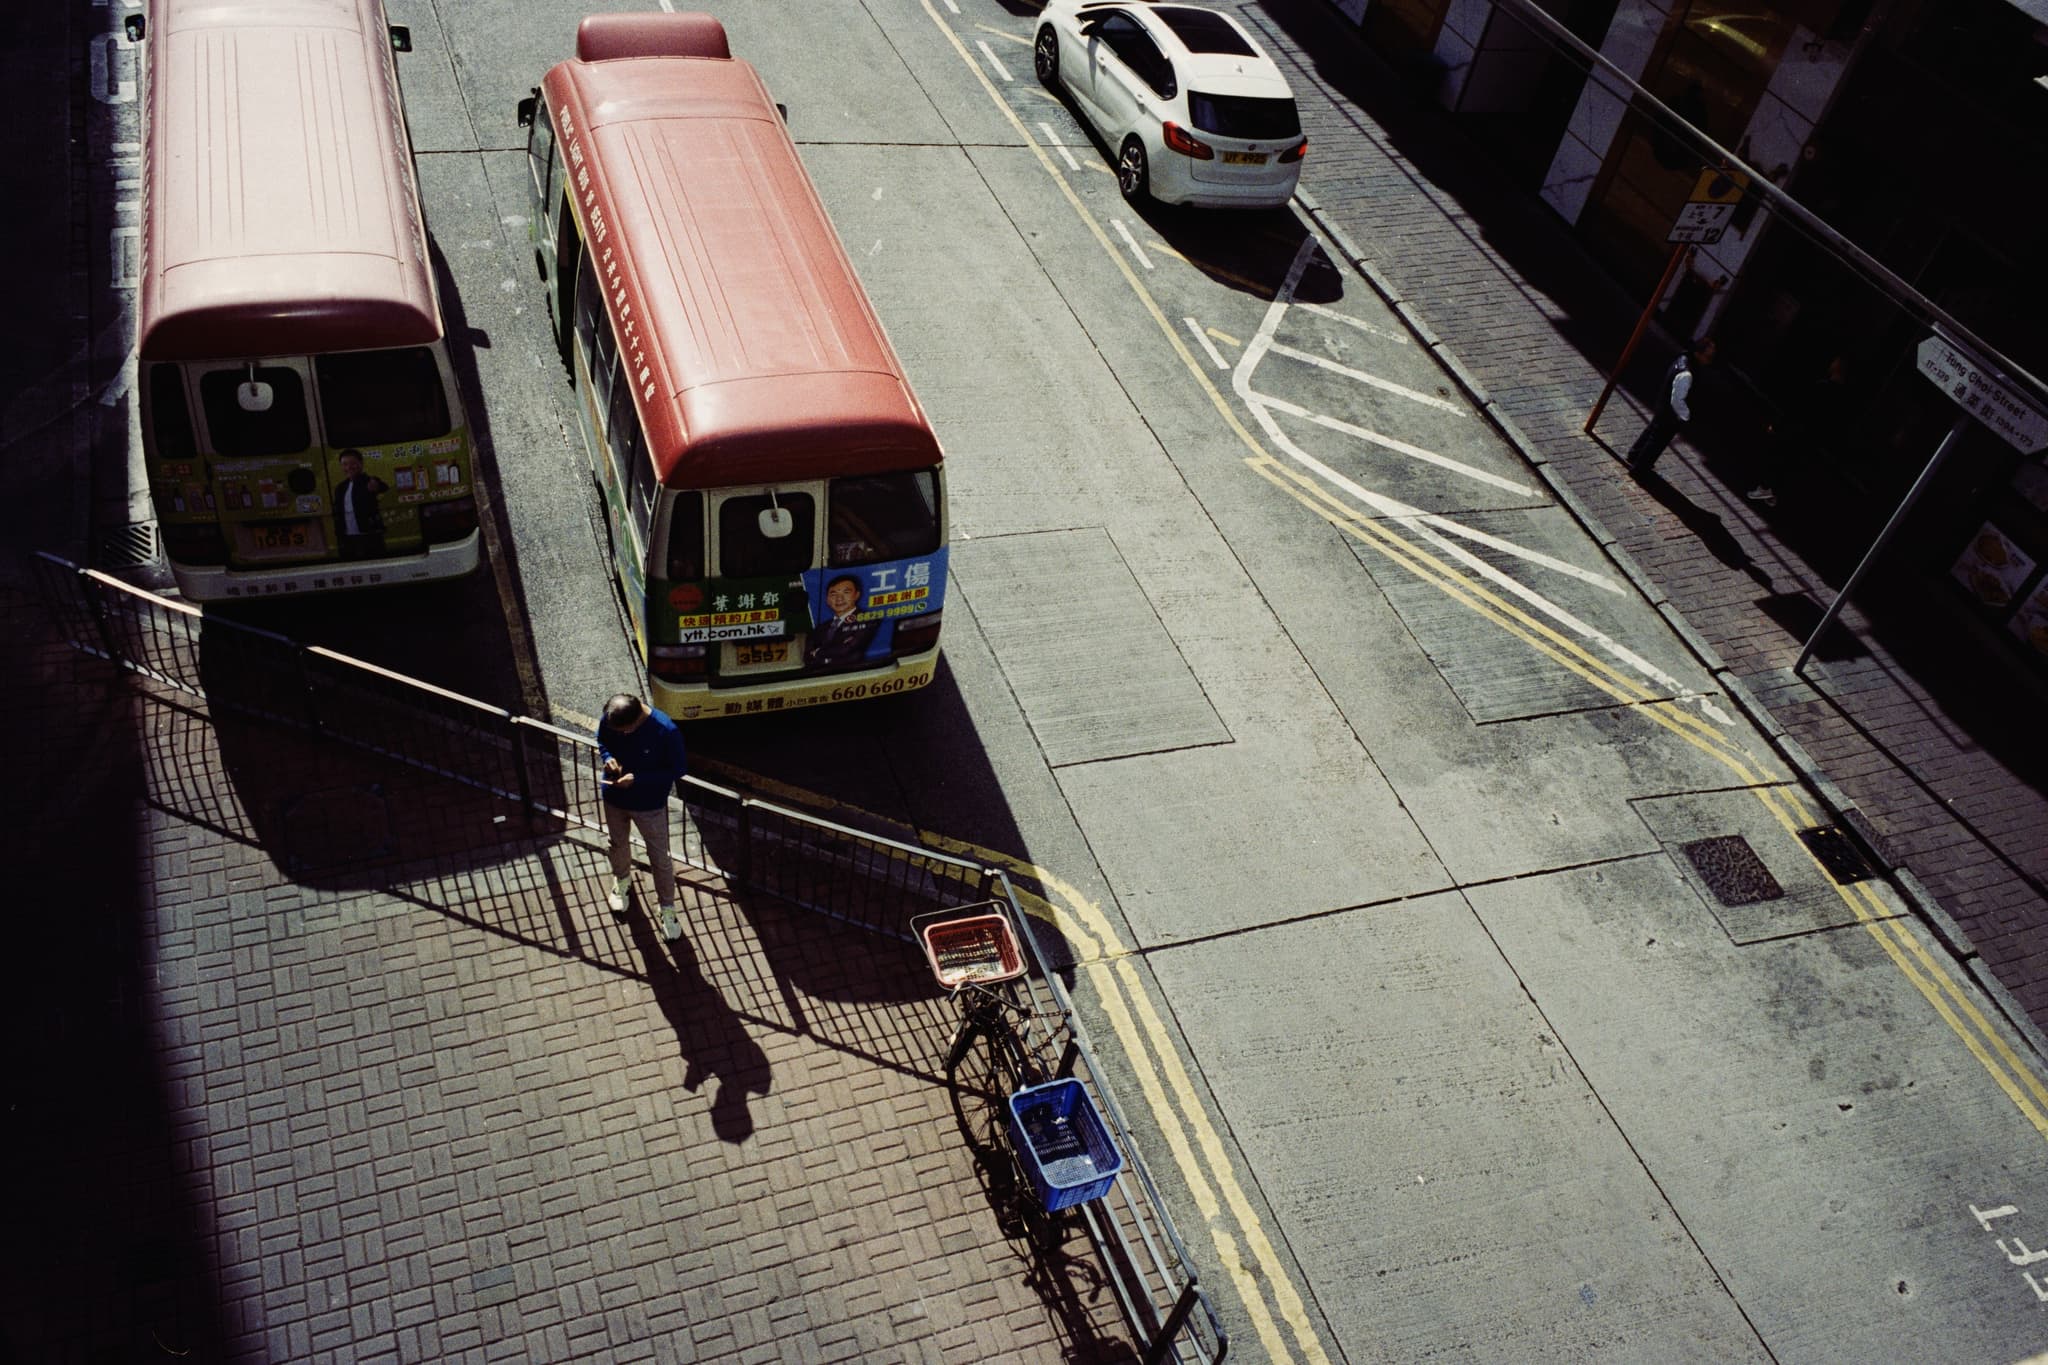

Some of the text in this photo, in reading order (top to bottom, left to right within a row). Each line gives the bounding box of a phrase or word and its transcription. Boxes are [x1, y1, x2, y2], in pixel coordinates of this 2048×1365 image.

[560, 104, 574, 140] PUBLIC
[569, 137, 583, 169] LIGHT
[578, 166, 590, 192] BUS
[590, 205, 607, 243] SEATS
[1713, 206, 1725, 219] 7
[1703, 228, 1720, 241] 12
[1945, 351, 2027, 419] Tung Choi Street
[869, 561, 931, 593] 工傷
[712, 591, 780, 612] 葉謝鄧
[684, 625, 765, 642] ytt.com.hk
[831, 684, 867, 701] 660
[870, 678, 905, 696] 660
[908, 672, 929, 689] 90
